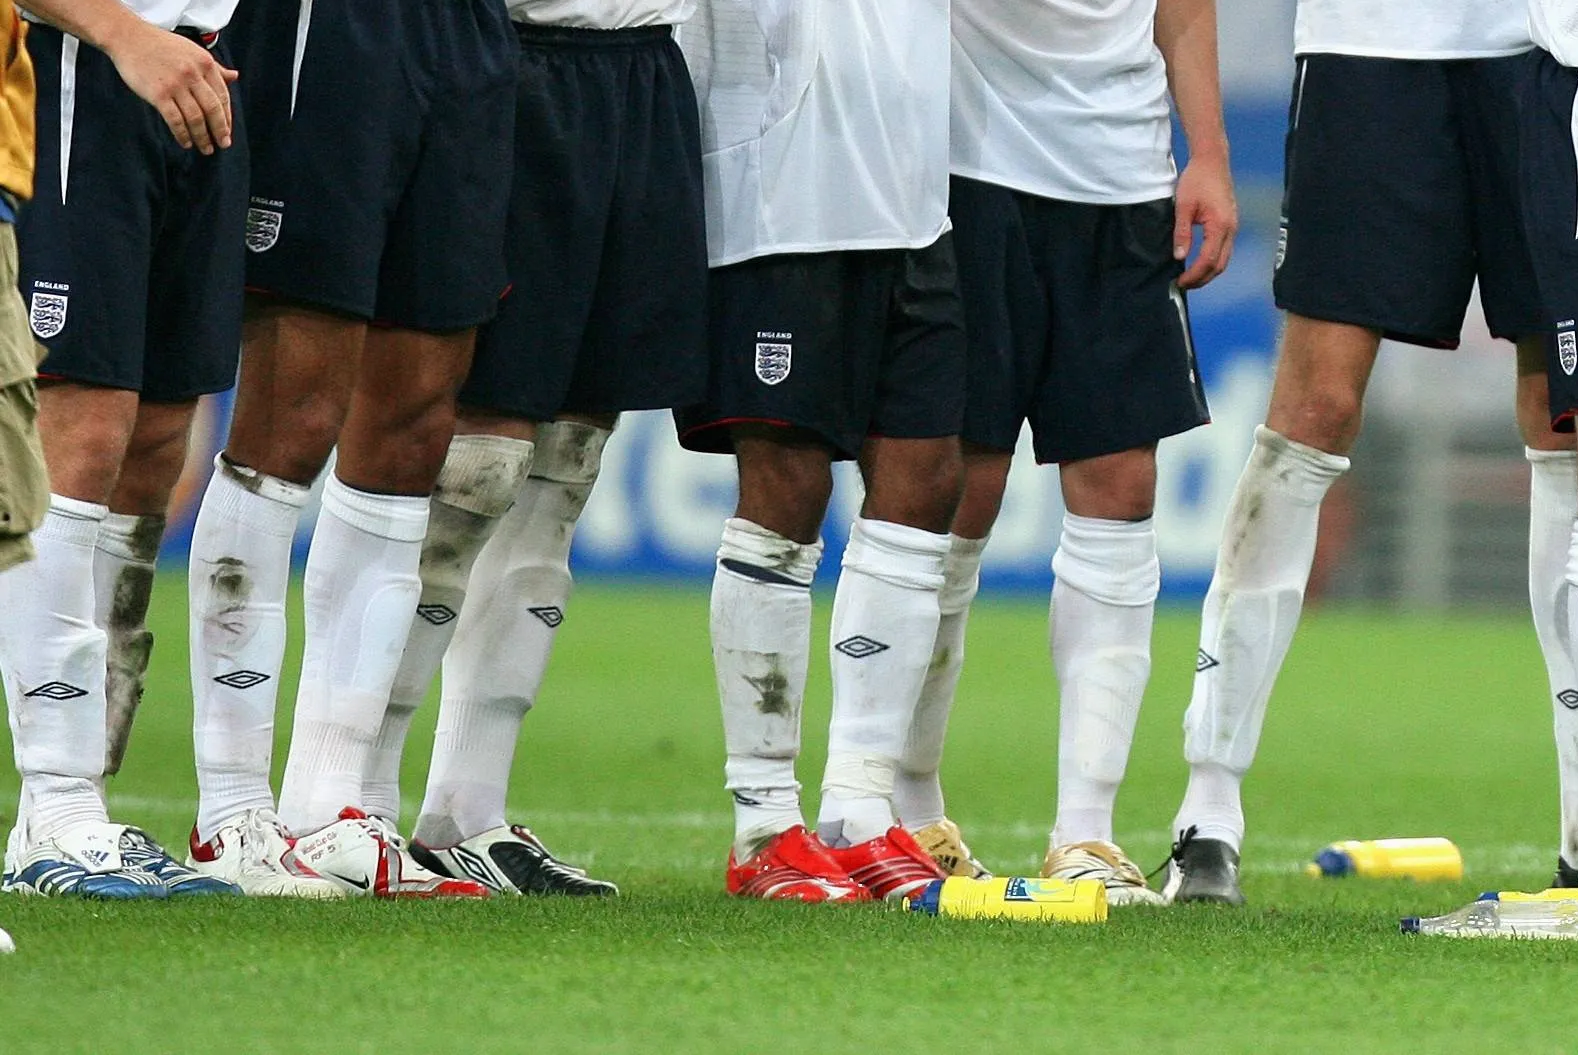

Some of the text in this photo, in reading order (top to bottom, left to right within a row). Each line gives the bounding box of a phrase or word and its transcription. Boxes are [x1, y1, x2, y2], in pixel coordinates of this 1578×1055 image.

[34, 280, 70, 291] ENGLAND
[757, 331, 792, 339] ENGLAND
[326, 844, 336, 854] 5
